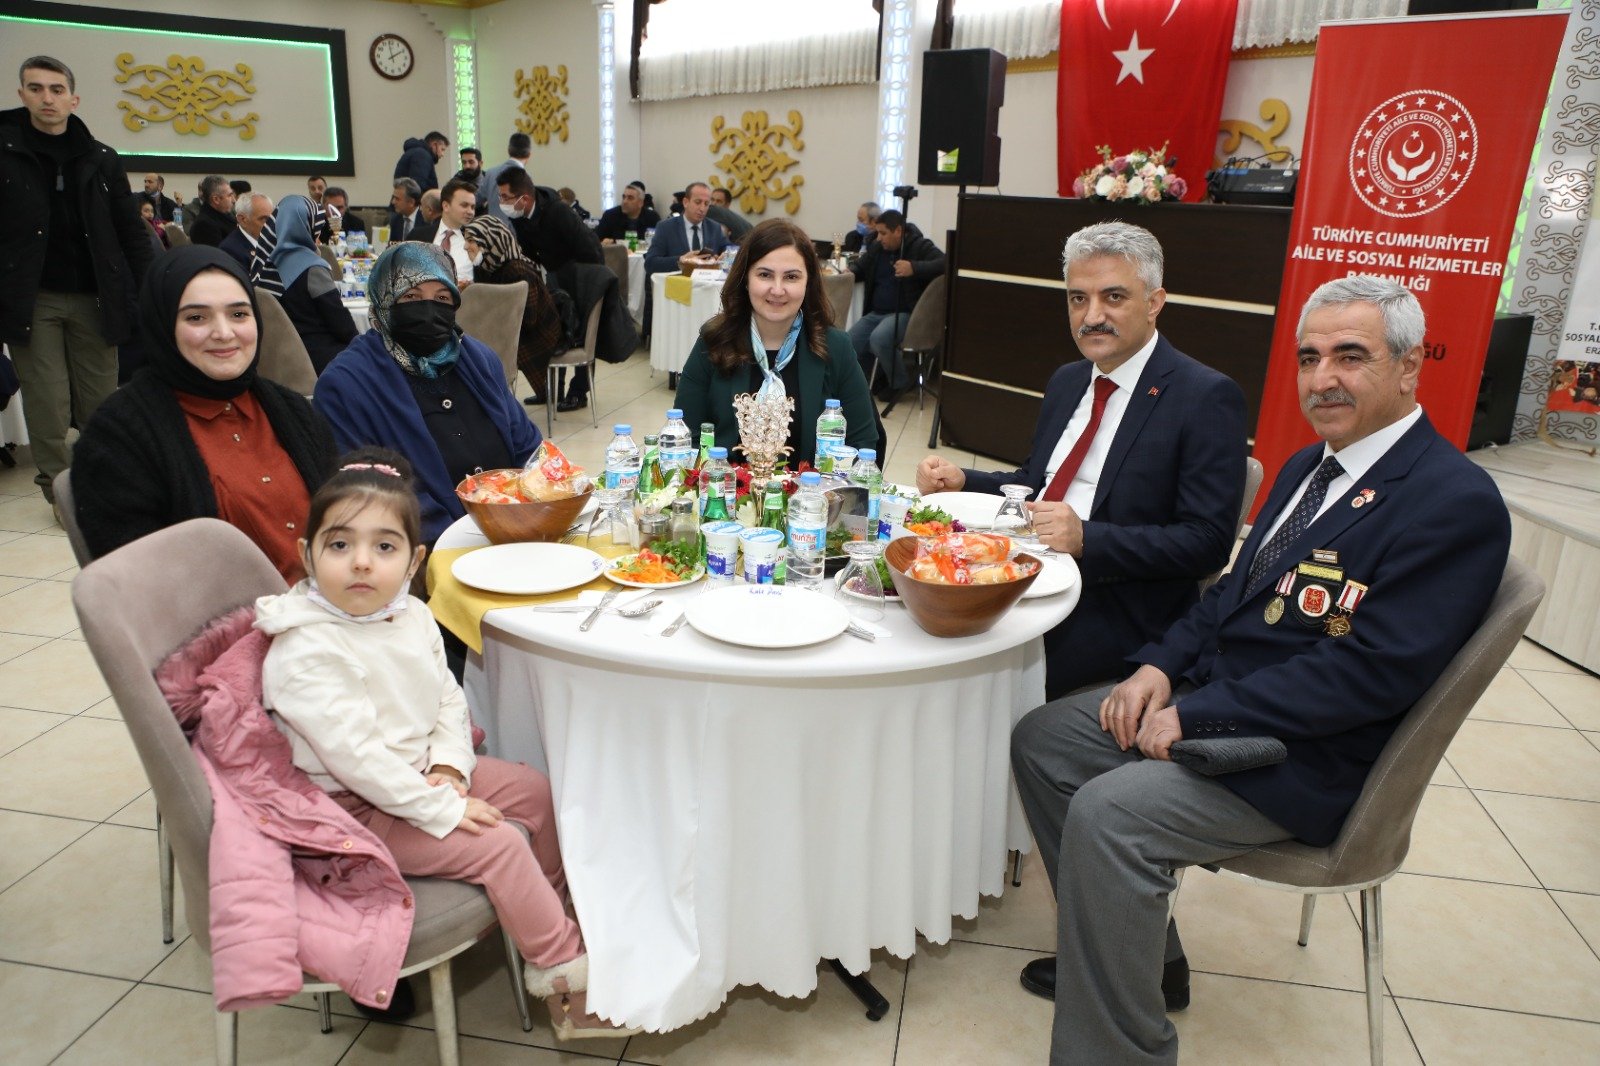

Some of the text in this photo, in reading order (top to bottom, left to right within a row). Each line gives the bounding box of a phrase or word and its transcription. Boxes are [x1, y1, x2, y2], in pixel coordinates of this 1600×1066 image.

[1392, 114, 1409, 128] AİLE
[1418, 113, 1444, 129] SOSYAL
[1312, 225, 1490, 254] TÜRKİYE CUMHURİYETİ
[1291, 243, 1503, 277] AİLE VE SOSYAL HİZMETLER
